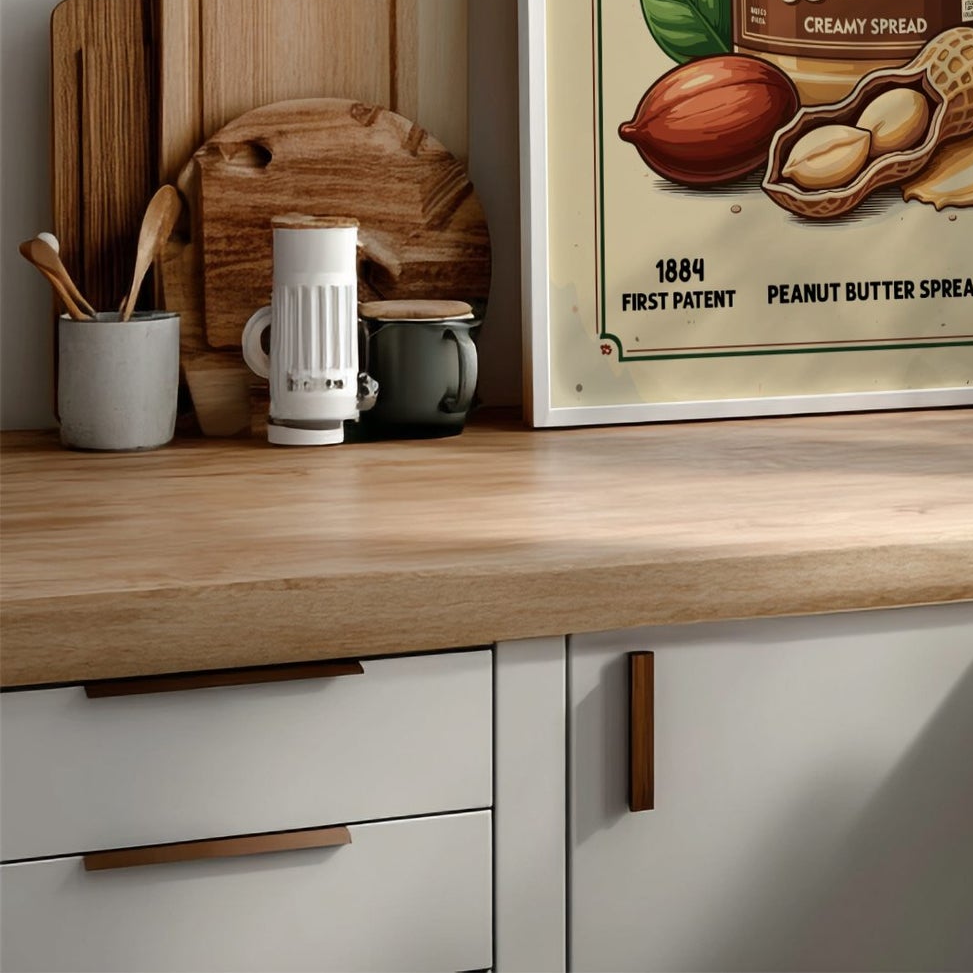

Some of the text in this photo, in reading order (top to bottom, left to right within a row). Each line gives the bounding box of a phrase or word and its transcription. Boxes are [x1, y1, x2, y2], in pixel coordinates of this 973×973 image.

[804, 16, 928, 35] CREAMY SPREAD
[655, 258, 704, 283] 1884
[622, 289, 736, 311] FIRST PATENT
[767, 282, 841, 304] PEANUT
[845, 280, 915, 301] BUTTER
